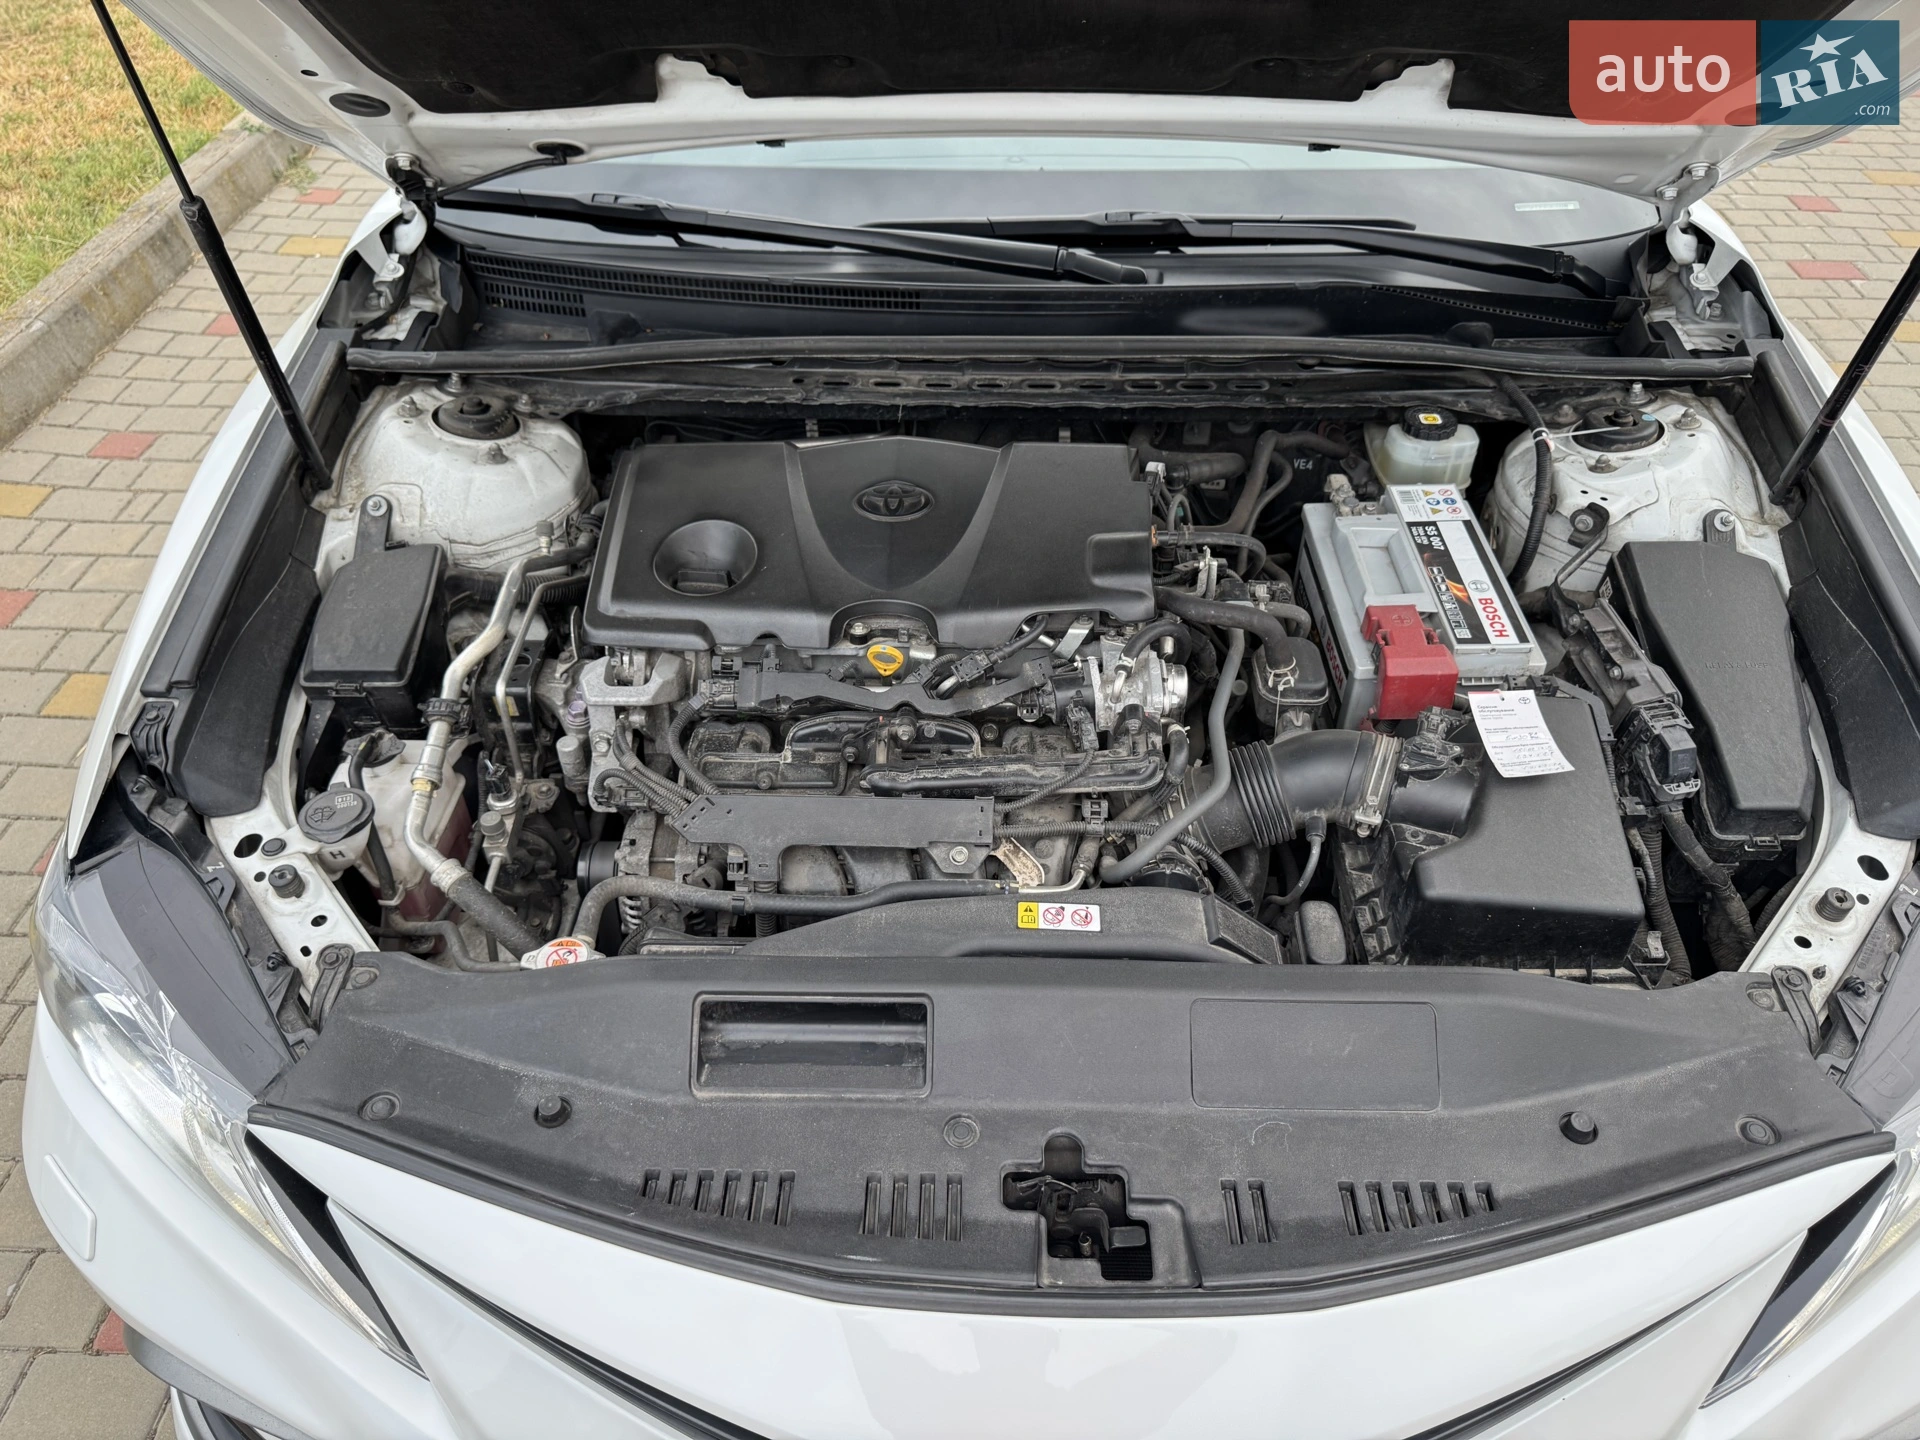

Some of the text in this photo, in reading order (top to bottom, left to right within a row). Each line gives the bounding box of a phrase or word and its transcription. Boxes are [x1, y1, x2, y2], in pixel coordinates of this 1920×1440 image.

[1293, 458, 1313, 470] VE4
[1429, 536, 1445, 551] 007
[1478, 597, 1510, 638] BOSCH
[1326, 635, 1344, 690] BOSCH
